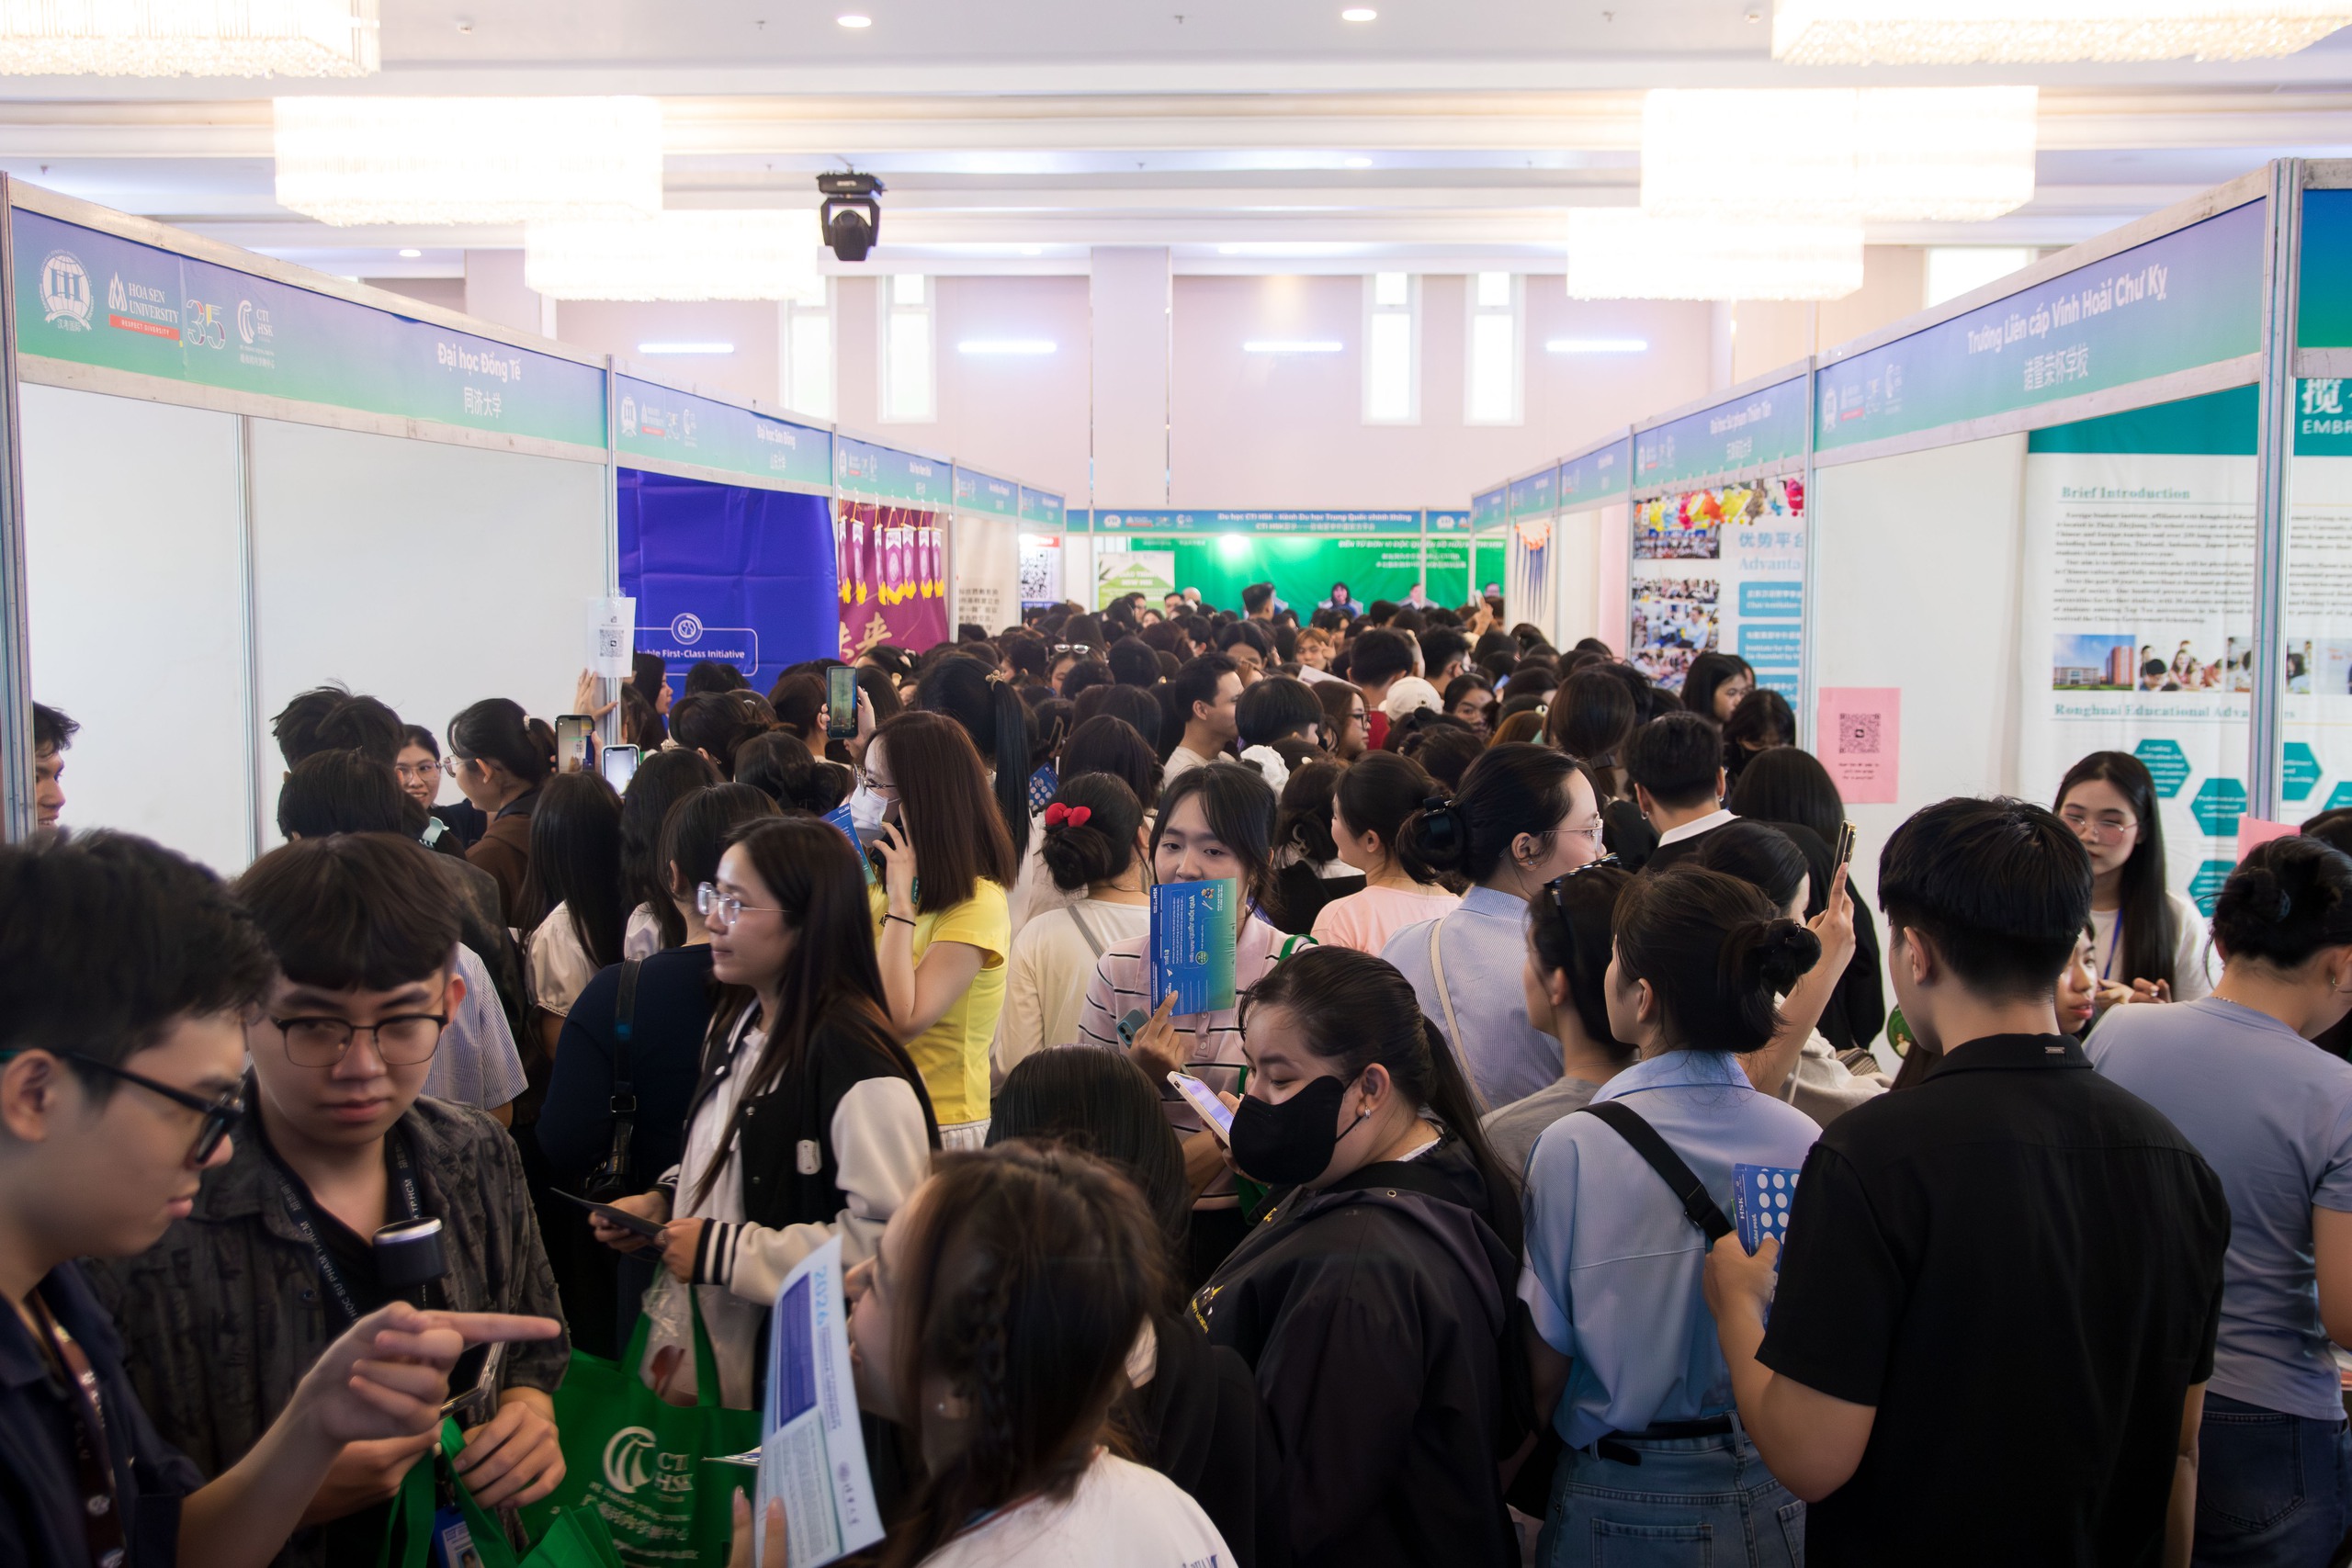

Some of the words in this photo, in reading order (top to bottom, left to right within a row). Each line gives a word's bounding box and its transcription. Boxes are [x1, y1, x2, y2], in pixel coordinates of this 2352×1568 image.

[129, 283, 147, 300] HOA
[149, 288, 165, 304] SEN
[130, 299, 179, 323] UNIVERSITY
[256, 308, 269, 322] CTI
[1968, 324, 2003, 354] Trường
[2004, 313, 2027, 344] Liên
[2029, 301, 2050, 338] cấp
[2052, 294, 2080, 328] Vĩnh
[2082, 278, 2112, 319] Hoài
[2116, 270, 2145, 307] Chư
[121, 319, 142, 332] RESPECT
[144, 323, 170, 335] DIVERSITY
[257, 322, 274, 337] HSK
[437, 342, 457, 372] Đại
[458, 345, 479, 377] học
[481, 351, 508, 383] Đồng
[509, 358, 521, 381] Tế
[464, 387, 502, 419] 同济大学
[2062, 486, 2097, 499] Brief
[2100, 487, 2190, 499] Introduction
[662, 649, 707, 659] First-Class
[707, 649, 745, 660] Initiative
[2054, 704, 2122, 716] Ronghuai
[2125, 705, 2210, 717] Educational
[403, 1178, 420, 1213] TP.HCM
[1738, 1196, 1747, 1220] HSK
[318, 1253, 341, 1282] PHẠM
[333, 1281, 347, 1297] SƯ
[814, 1265, 829, 1326] 2026
[342, 1296, 359, 1318] HỌC
